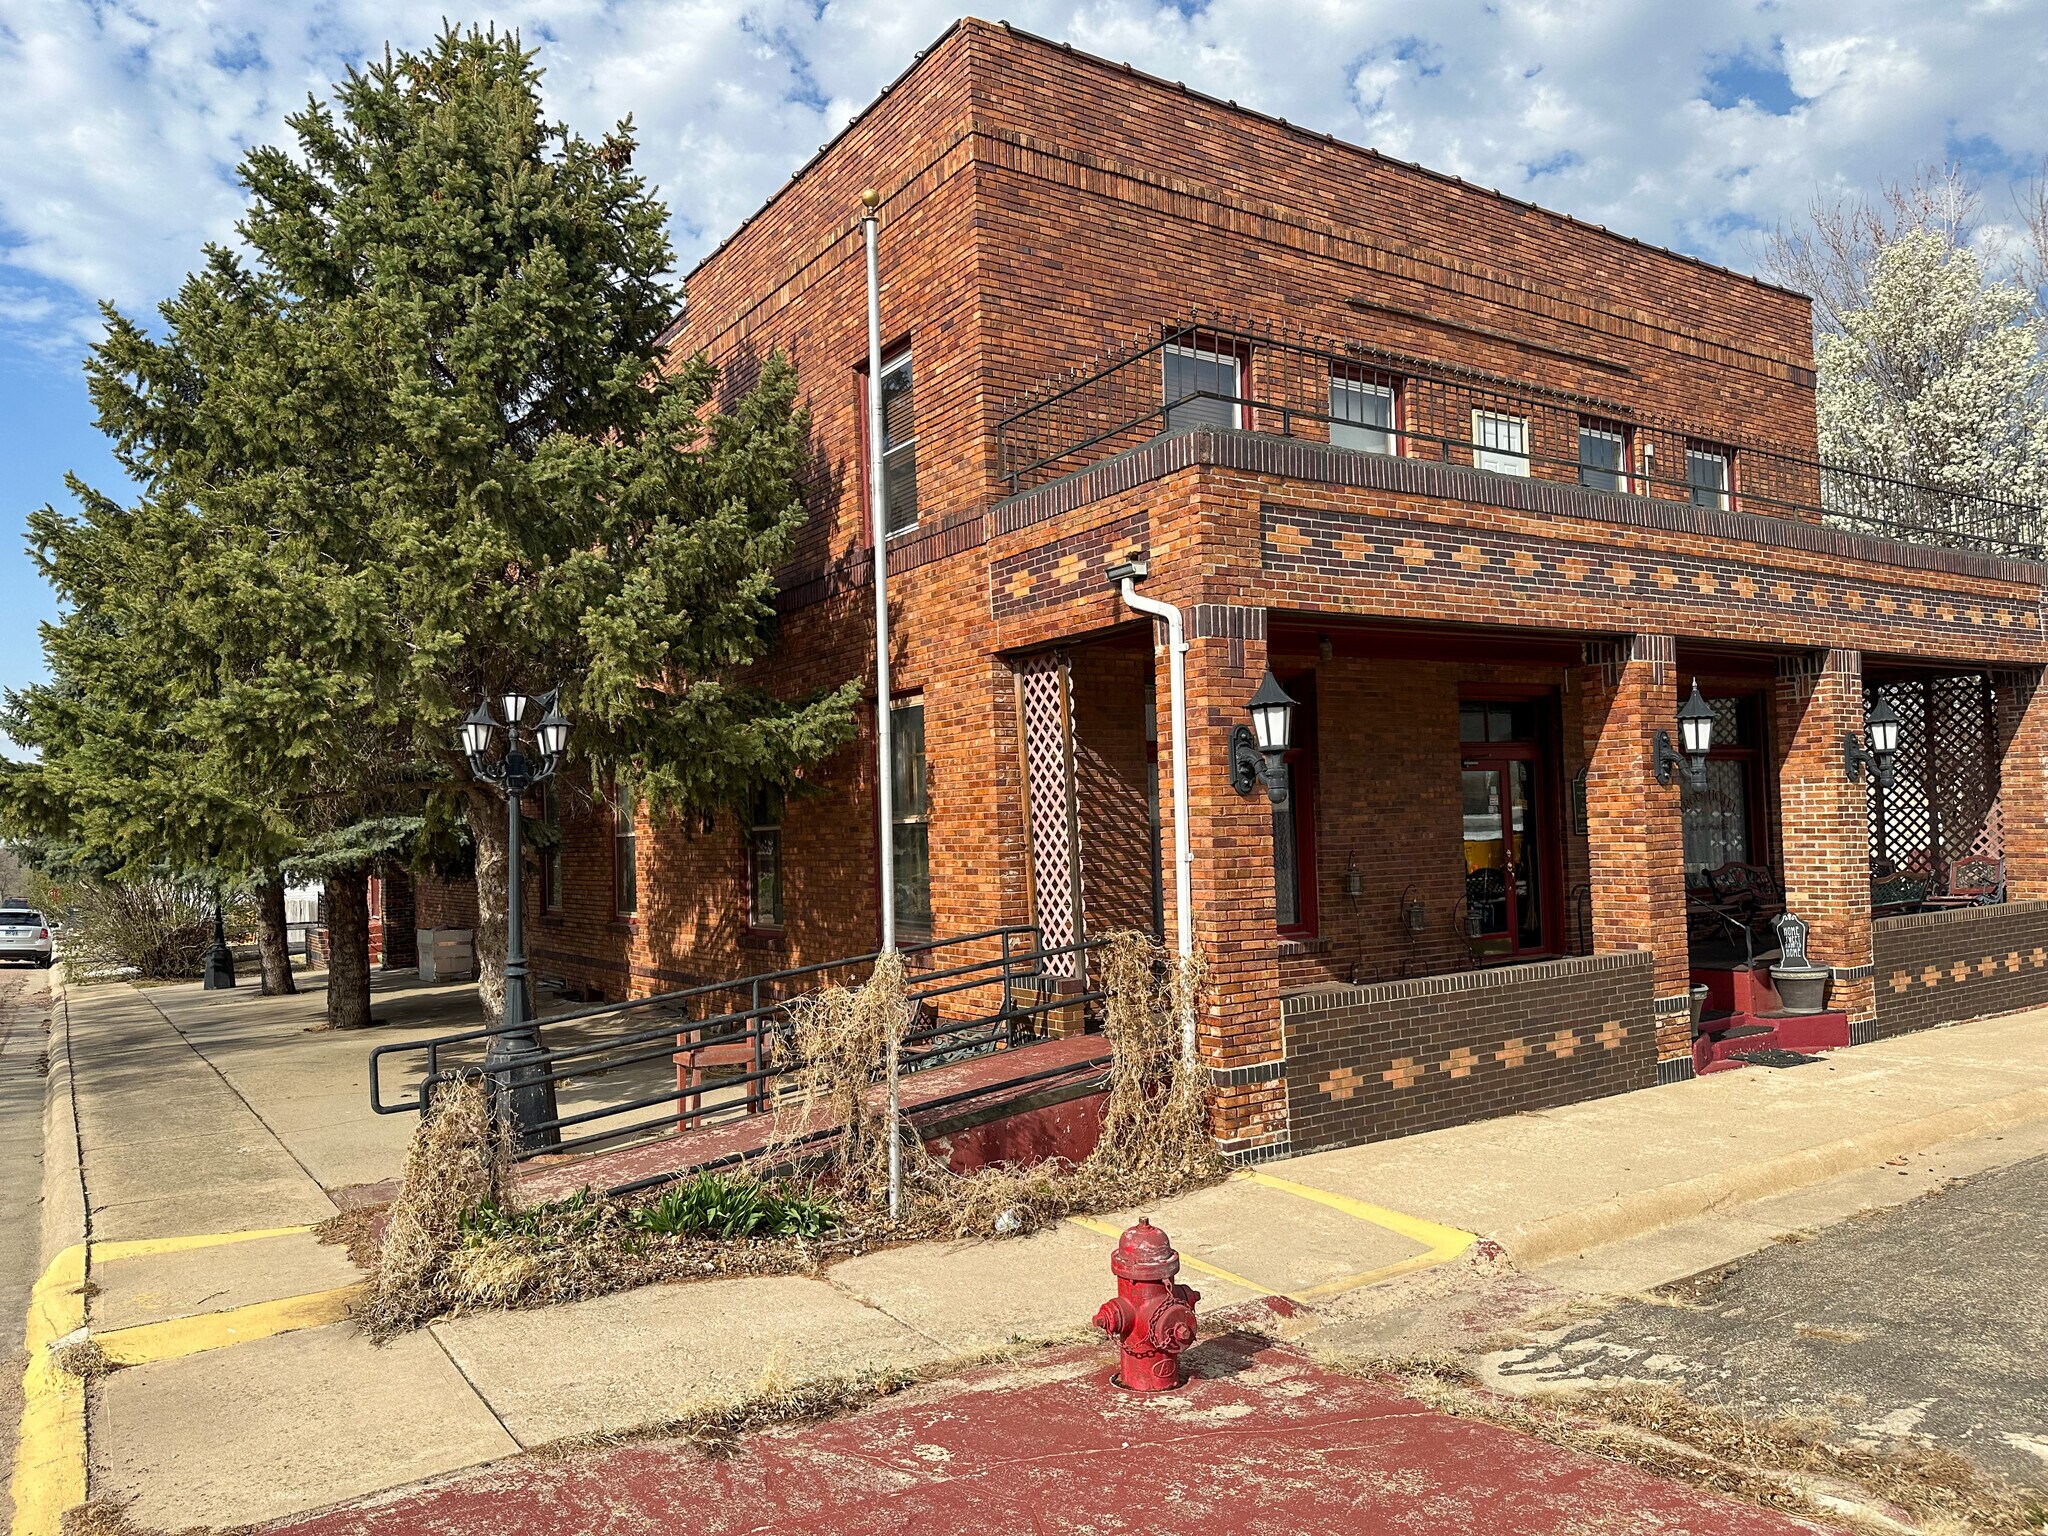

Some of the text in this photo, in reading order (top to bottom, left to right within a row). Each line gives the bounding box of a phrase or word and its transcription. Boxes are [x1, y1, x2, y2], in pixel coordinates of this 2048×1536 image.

[1708, 789, 1737, 815] HOTEL
[1783, 926, 1800, 936] HOME
[1785, 935, 1800, 943] SWEET
[1785, 948, 1801, 957] HOME
